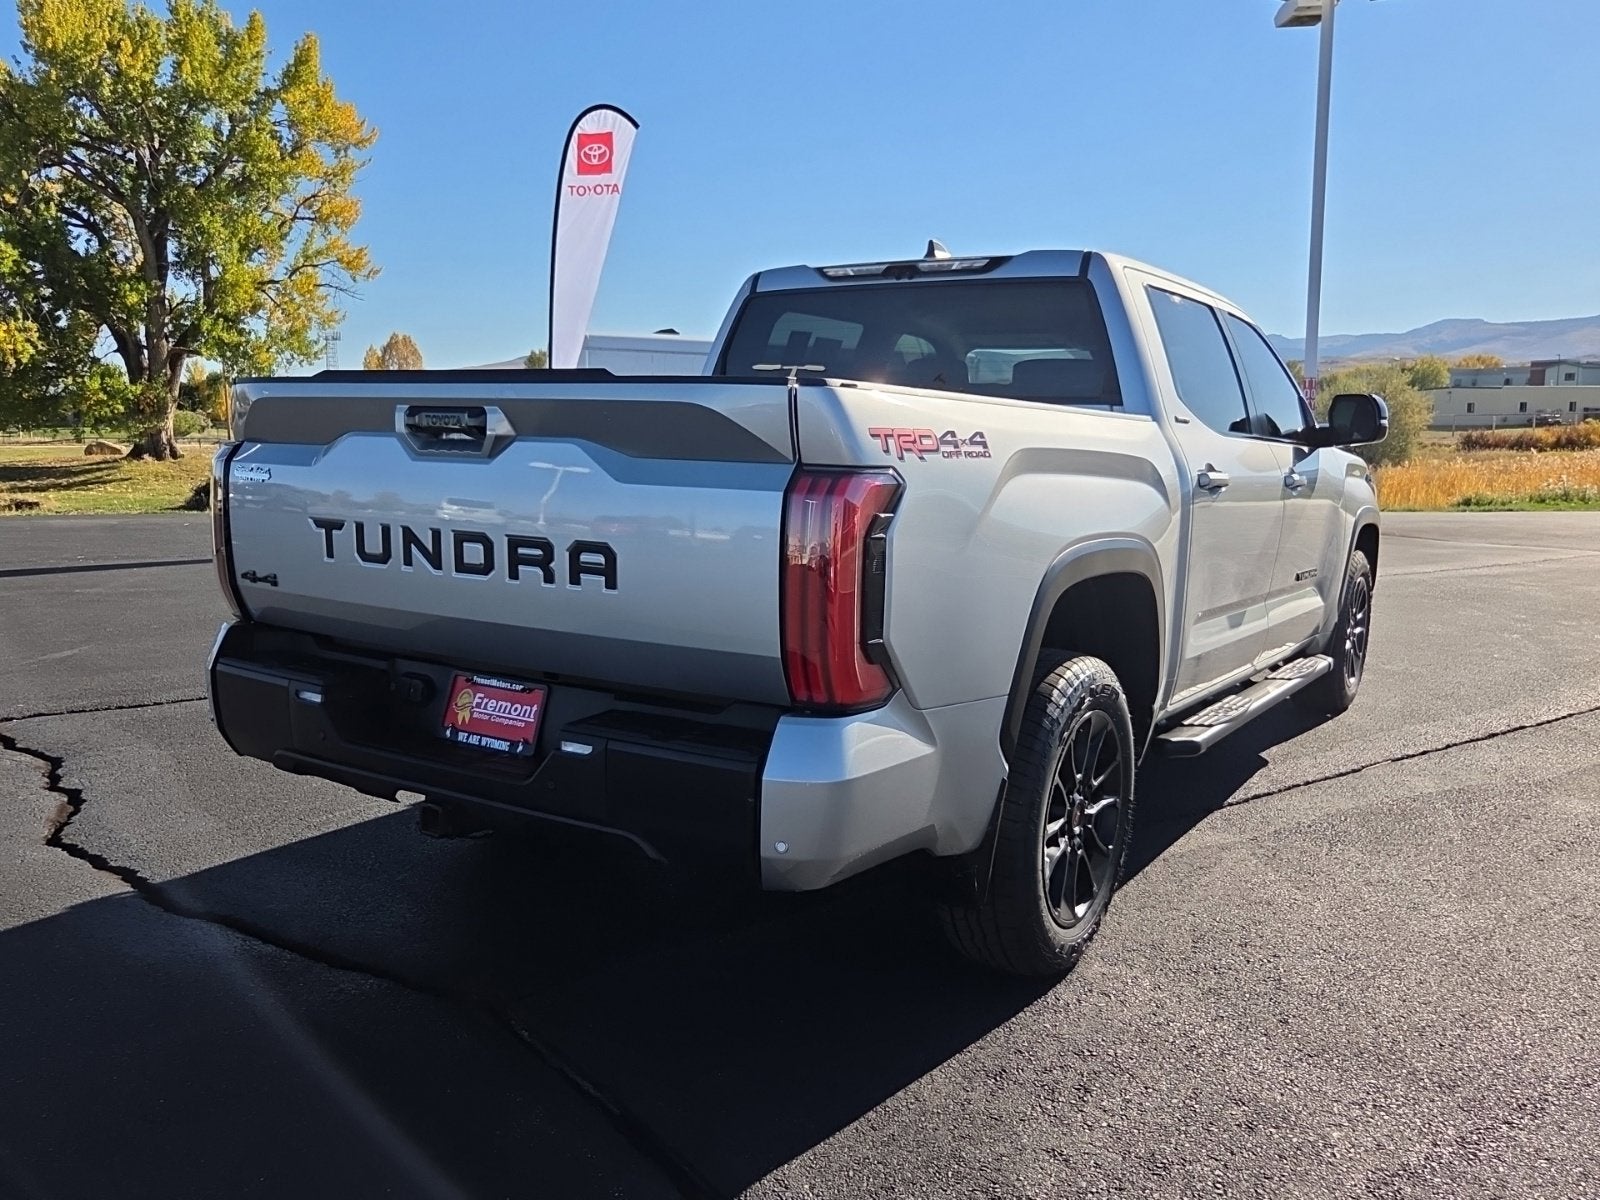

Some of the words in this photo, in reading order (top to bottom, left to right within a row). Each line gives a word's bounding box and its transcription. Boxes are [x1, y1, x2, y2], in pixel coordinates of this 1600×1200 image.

[568, 184, 620, 197] TOYOTA
[424, 414, 464, 428] TOYOTA
[868, 428, 940, 462] TRD
[941, 450, 962, 459] OFF
[964, 450, 991, 459] ROAD
[308, 516, 618, 594] TUNDRA
[473, 693, 537, 719] Fremont
[472, 712, 490, 720] Motor
[490, 715, 525, 727] Companies
[457, 732, 468, 742] WE
[469, 734, 480, 745] ARE
[481, 736, 511, 752] WYOMING
